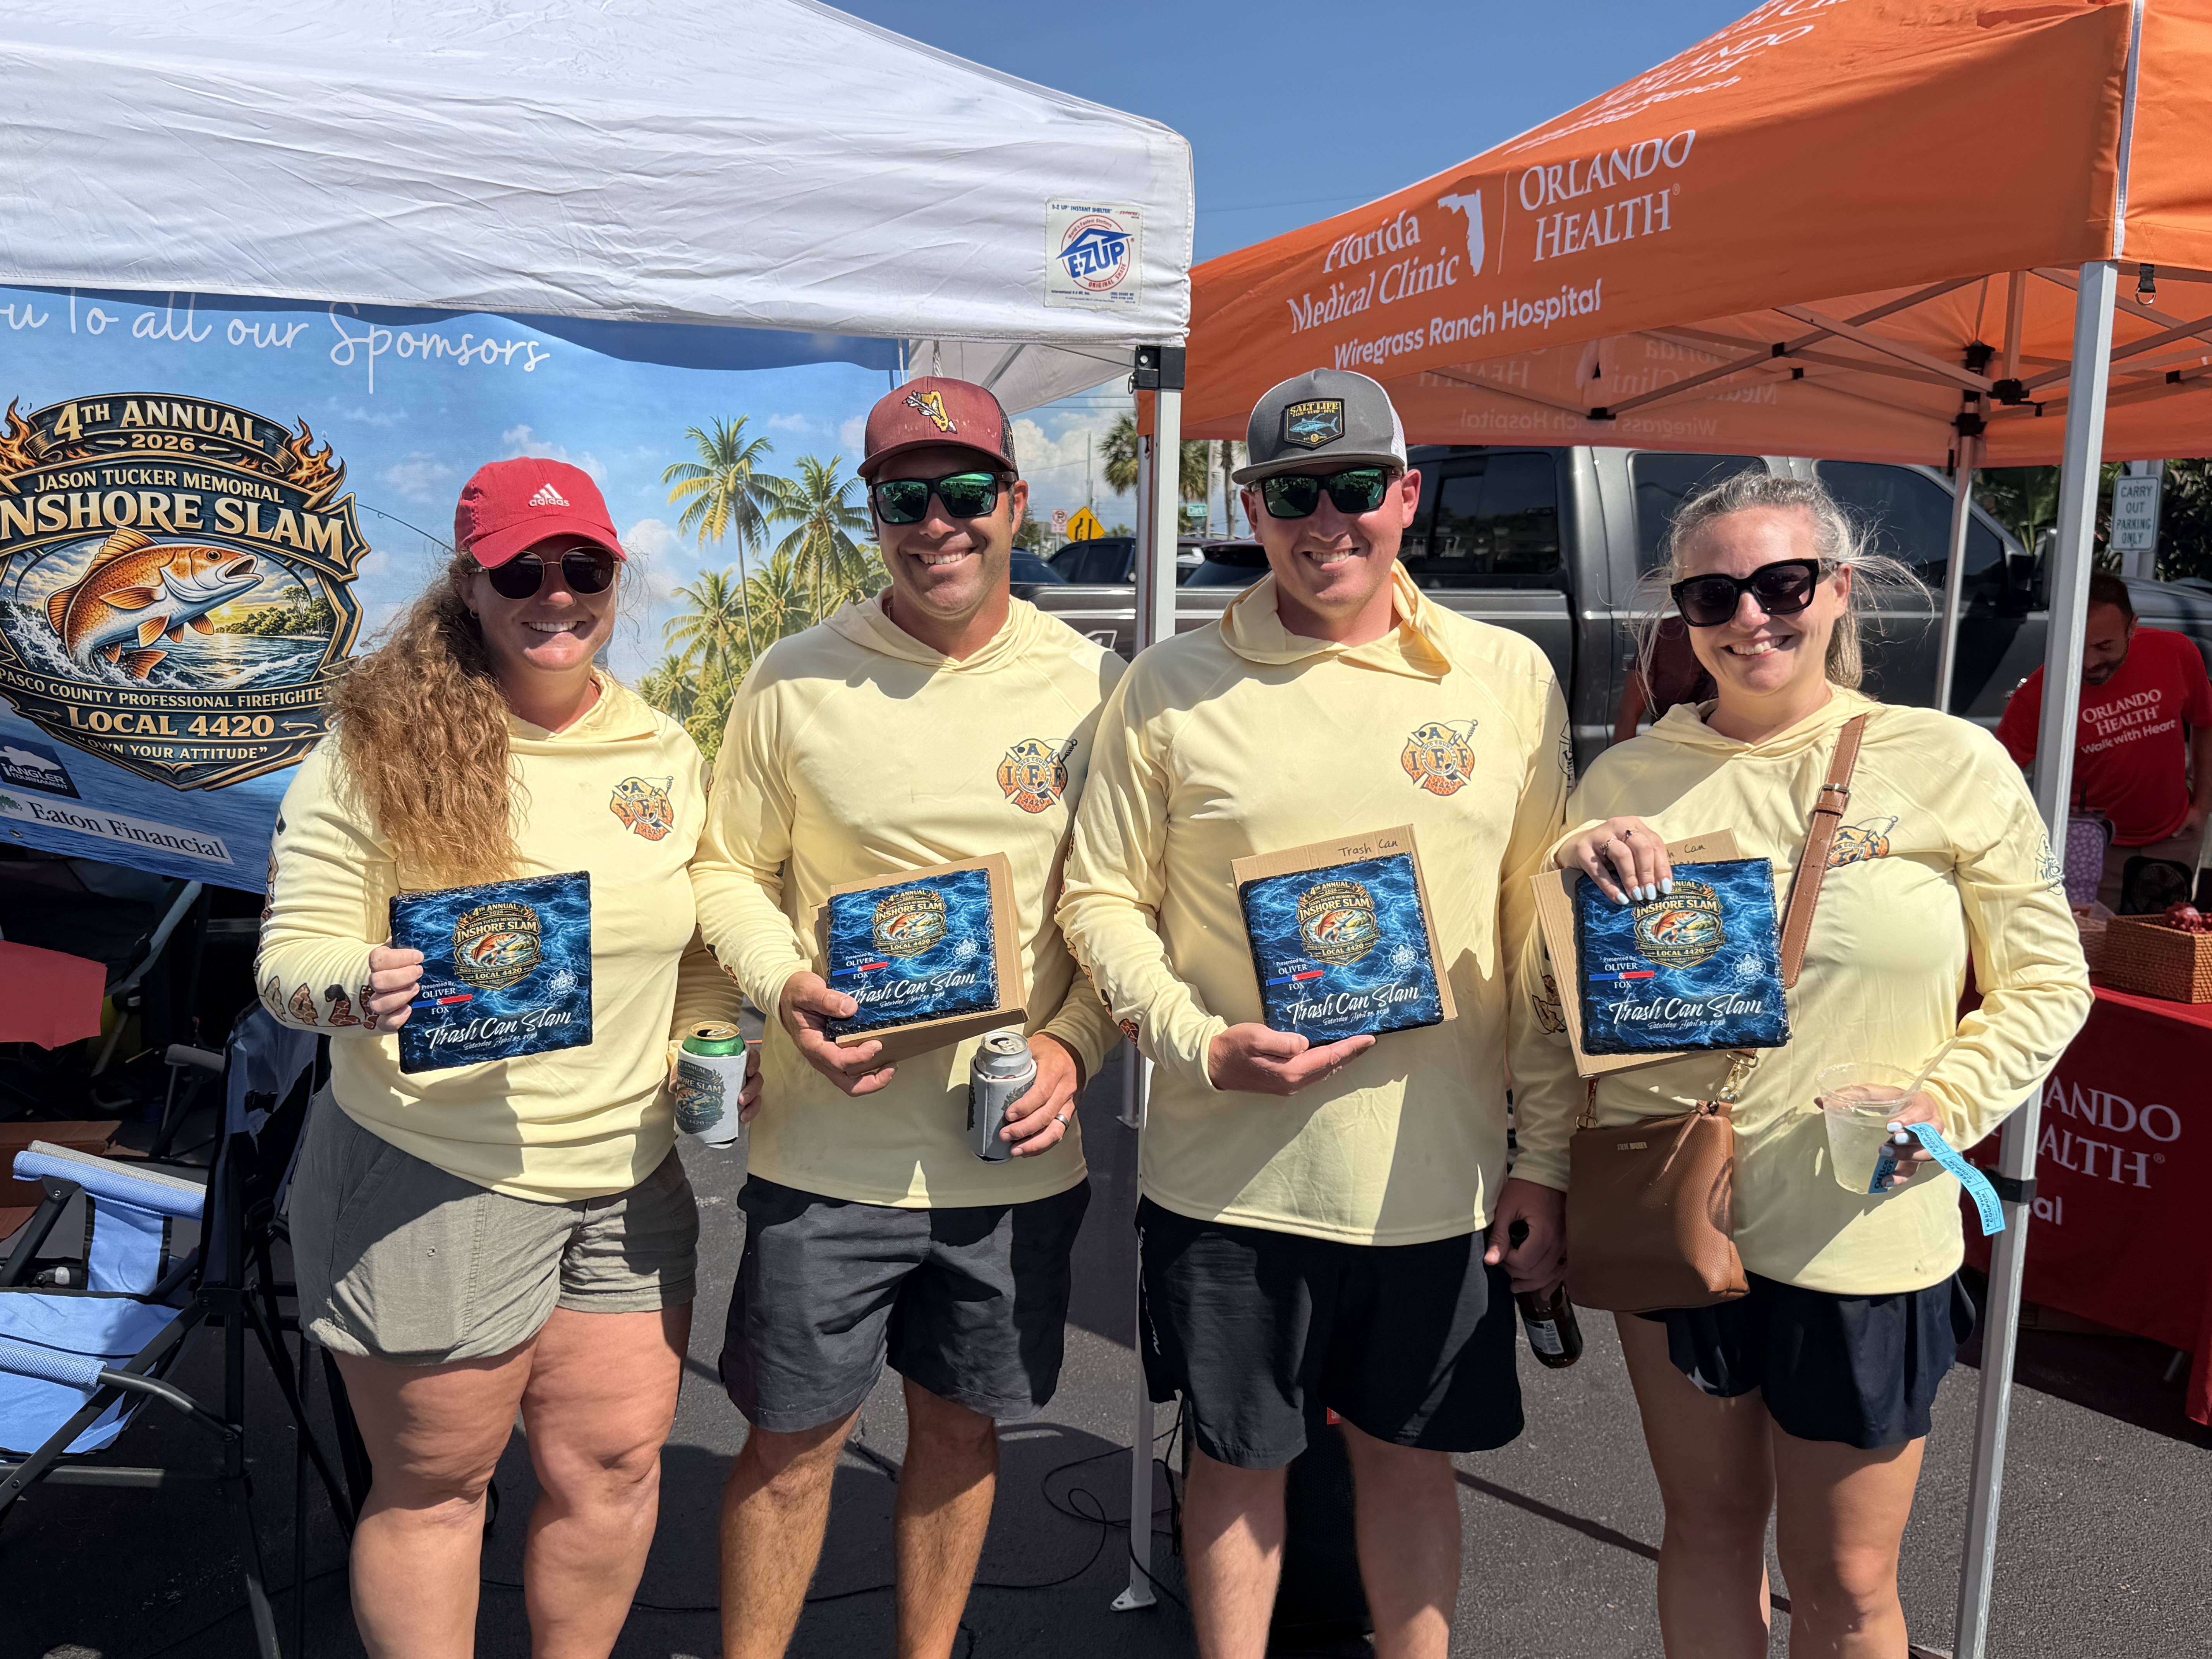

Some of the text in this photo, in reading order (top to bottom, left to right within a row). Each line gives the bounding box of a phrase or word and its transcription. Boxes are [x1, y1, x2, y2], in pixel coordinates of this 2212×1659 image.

[1519, 129, 1696, 211] ORLANDO
[1322, 210, 1421, 273] Florida
[1088, 263, 1127, 288] ORIGINAL SHADE
[1286, 246, 1460, 334] Medical Clinic
[132, 290, 213, 342] all
[227, 318, 309, 349] our
[1334, 278, 1602, 370] Wiregrass Ranch Hospital
[1290, 403, 1315, 415] SALT
[53, 400, 264, 448] 4TH ANNUAL
[131, 434, 195, 452] 2026
[34, 469, 284, 504] JASON TUCKER MEMORIAL
[2120, 486, 2154, 498] CARRY
[529, 497, 570, 507] adidas
[2126, 502, 2145, 514] OUT
[2116, 519, 2152, 531] PARKING
[214, 498, 345, 568] SLAM
[2121, 532, 2145, 544] ONLY
[50, 684, 114, 704] COUNTY
[118, 692, 234, 708] PROFESSIONAL
[2081, 689, 2162, 724] ORLANDO
[67, 706, 275, 737] LOCAL 4420
[2081, 719, 2176, 755] Walk with Heart
[130, 744, 174, 759] YOUR
[10, 773, 68, 790] TOURNAMENT
[1432, 780, 1456, 788] 4420
[1023, 798, 1045, 806] 4420
[26, 800, 227, 859] Eaton Financial
[1338, 838, 1398, 857] Trash Can
[1684, 844, 1706, 854] Can
[900, 889, 927, 897] ANNUAL
[1322, 881, 1350, 890] ANNUAL
[876, 904, 916, 923] INSHORE
[917, 902, 943, 910] SLAM
[1299, 898, 1371, 921] INSHORE SLAM
[1636, 899, 1718, 918] INSHORE SLAM
[457, 921, 538, 944] INSHORE SLAM
[913, 938, 931, 946] 4420
[1346, 943, 1364, 951] 4420
[846, 957, 874, 967] OLIVER
[1276, 958, 1296, 967] Presented
[1278, 963, 1308, 975] OLIVER
[1604, 962, 1638, 972] OLIVER
[502, 968, 522, 976] 4420
[853, 972, 869, 980] FOX
[421, 982, 447, 990] Presented
[848, 969, 976, 1005] Trash Can Slam
[1288, 982, 1305, 991] FOX
[1614, 980, 1632, 989] FOX
[422, 988, 456, 999] OLIVER
[431, 1006, 450, 1015] FOX
[1286, 981, 1419, 1025] Trash Can Slam
[1608, 992, 1762, 1025] Trash Can Slam
[424, 1006, 572, 1049] Trash Can Slam
[1647, 1021, 1677, 1030] Saturday
[696, 1080, 722, 1094] SLAM
[1874, 1159, 1889, 1189] Office
[1955, 1170, 1972, 1183] KEEP
[1975, 1191, 1985, 1207] THIS
[1981, 1193, 1994, 1223] COUPON
